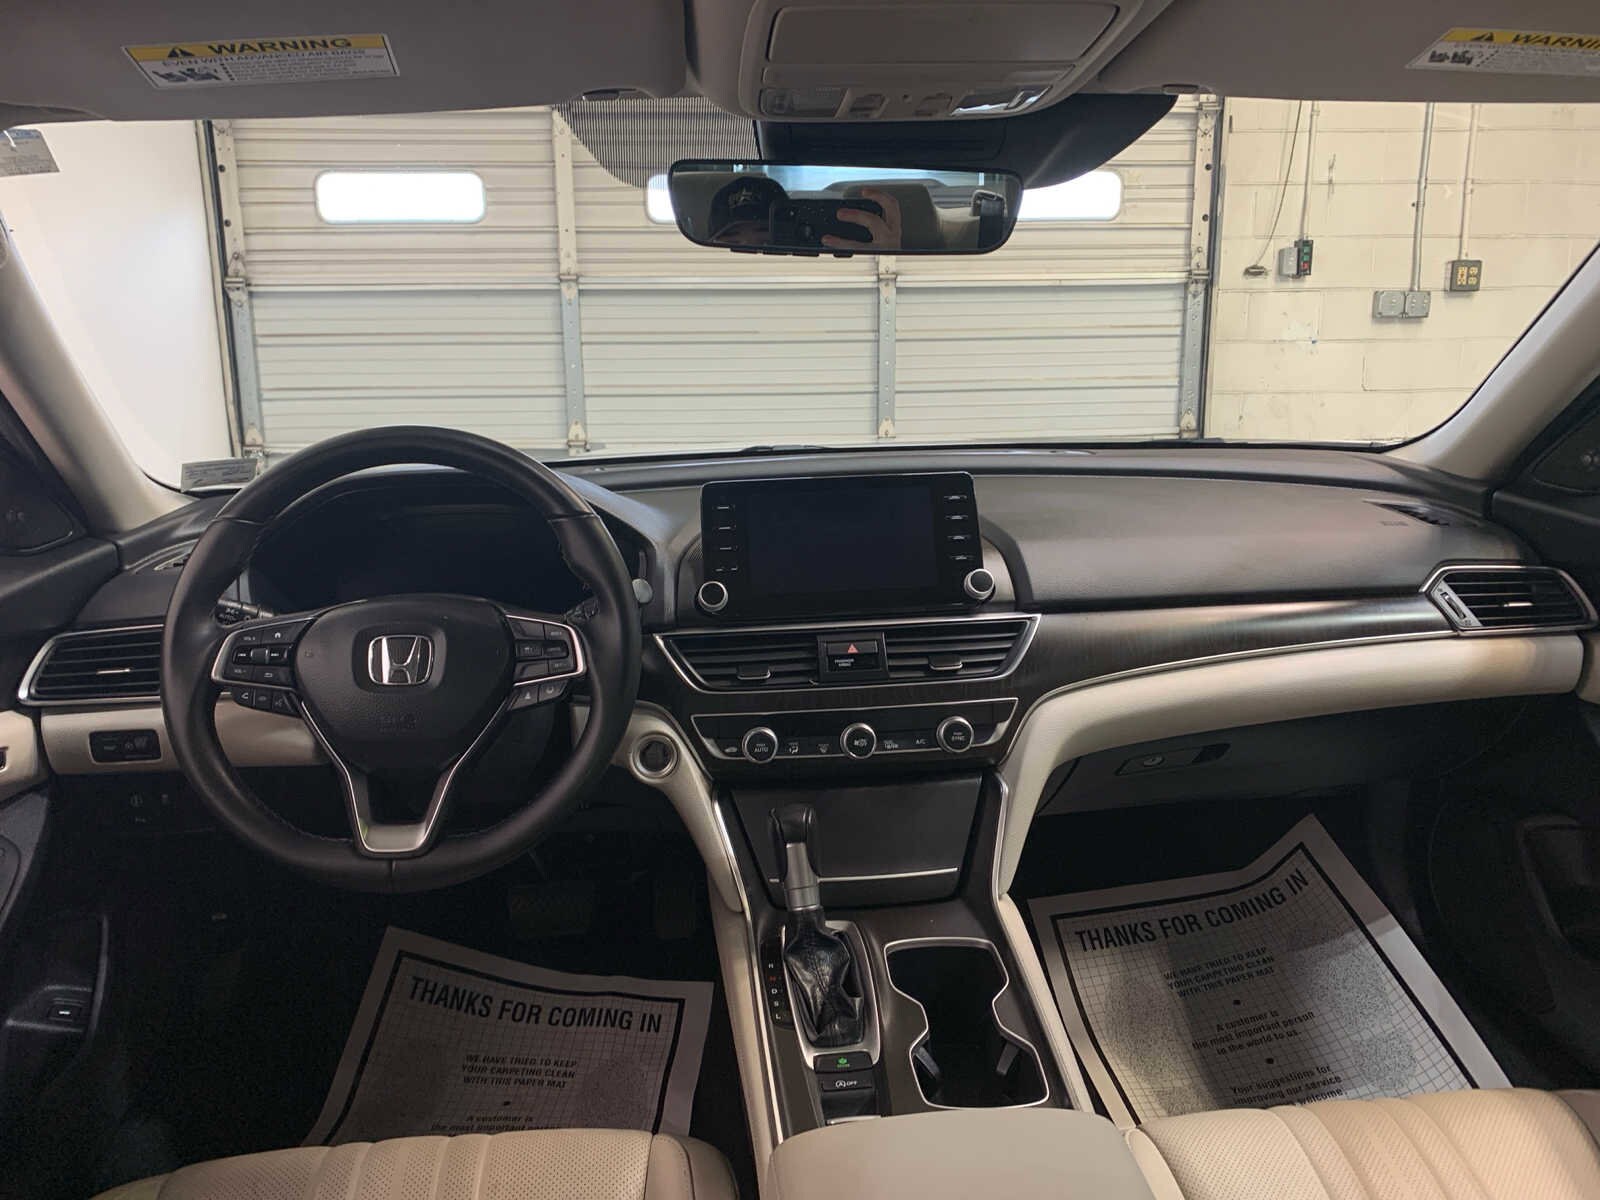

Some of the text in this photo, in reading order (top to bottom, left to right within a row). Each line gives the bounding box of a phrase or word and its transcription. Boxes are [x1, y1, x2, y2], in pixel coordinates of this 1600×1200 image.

[207, 38, 352, 55] WARNING
[1075, 868, 1309, 952] THANKS FOR COMING IN
[409, 976, 663, 1034] THANKS FOR COMING IN
[1225, 1013, 1270, 1031] customer
[1235, 1019, 1282, 1042] important
[1283, 1011, 1315, 1030] person
[1246, 1035, 1273, 1049] world
[483, 1055, 506, 1064] HAVE
[510, 1056, 537, 1066] TRIED
[539, 1057, 552, 1067] TO
[554, 1059, 577, 1068] KEEP
[462, 1064, 576, 1080] YOUR CARPETING CLEAN
[463, 1075, 488, 1085] WITH
[514, 1078, 545, 1088] PAPER
[547, 1079, 568, 1089] MAT
